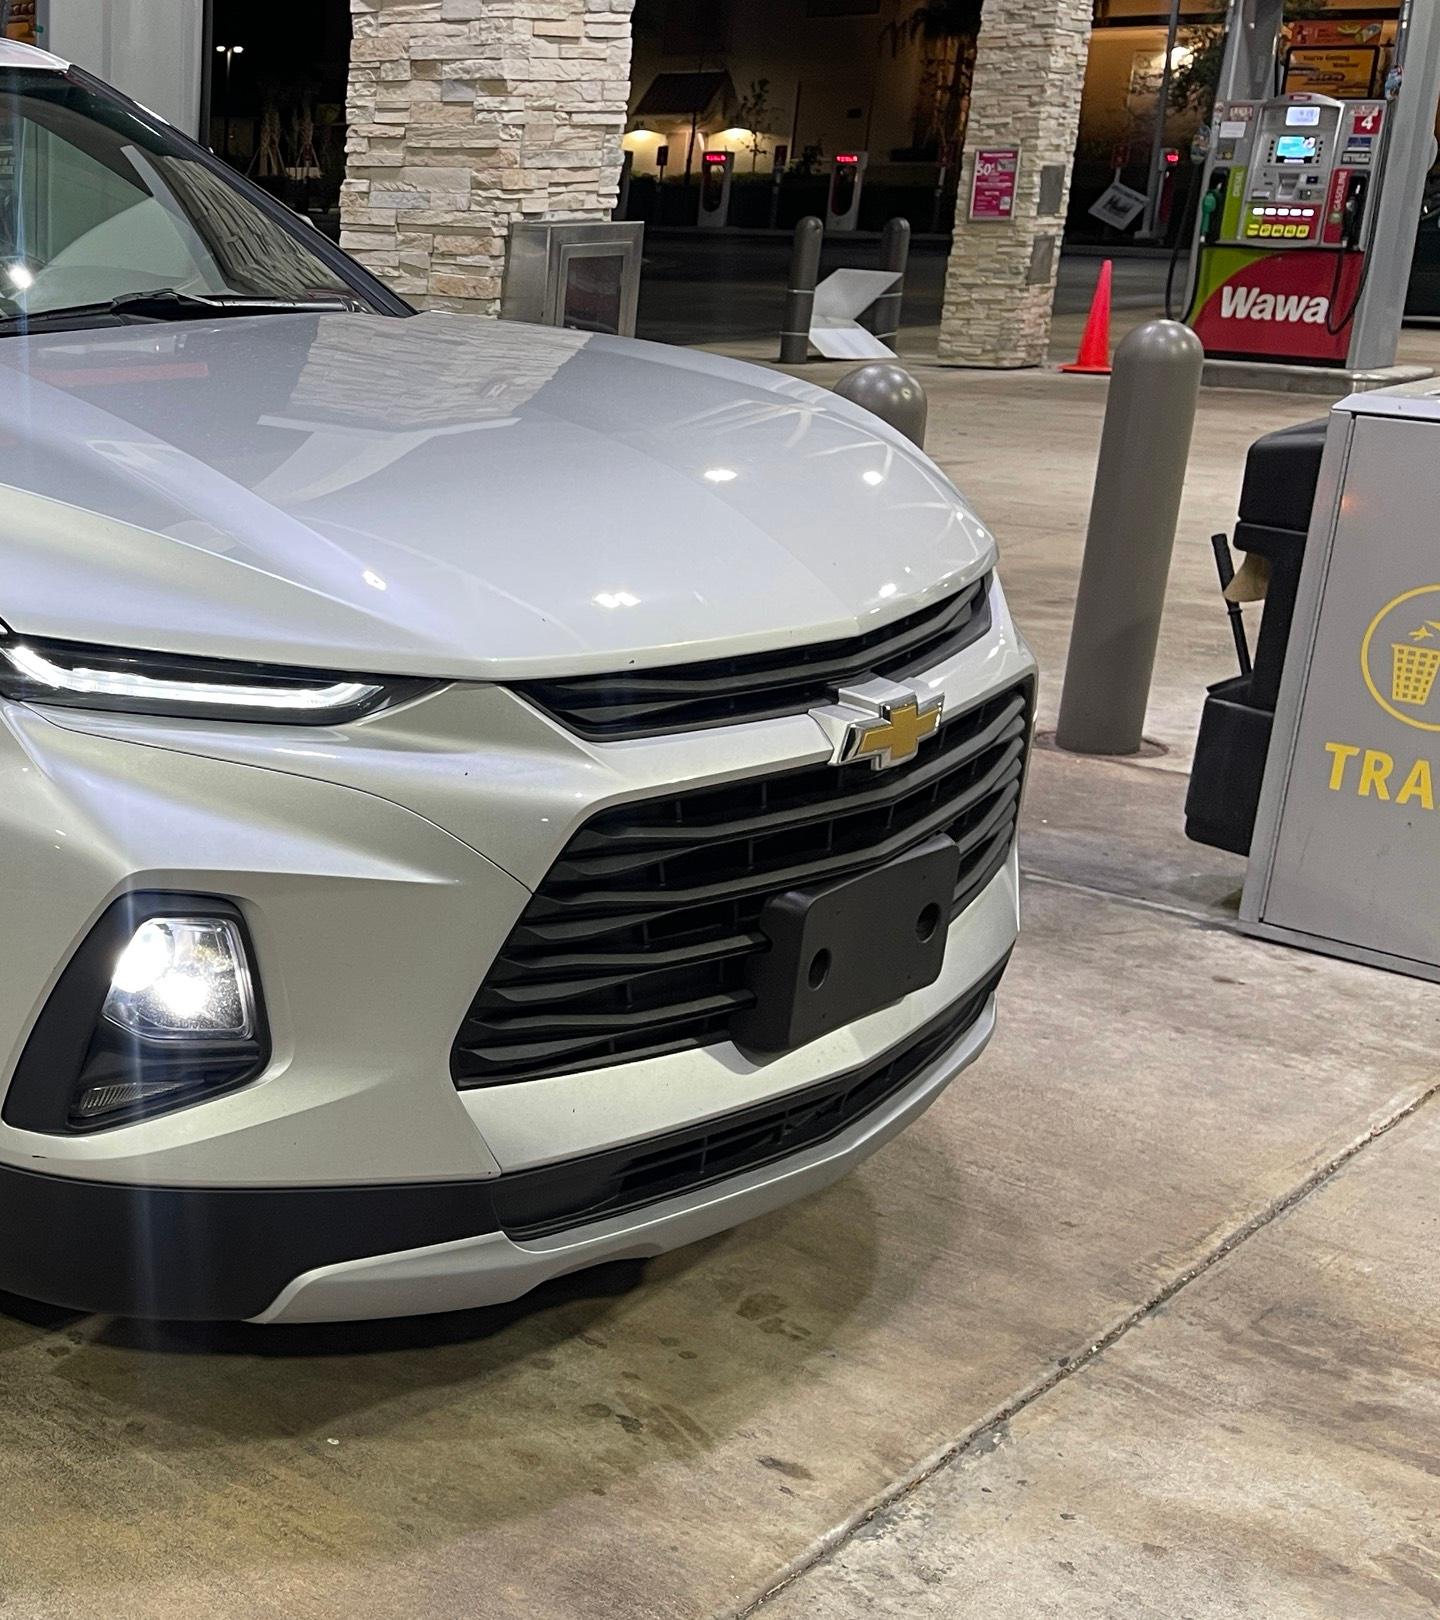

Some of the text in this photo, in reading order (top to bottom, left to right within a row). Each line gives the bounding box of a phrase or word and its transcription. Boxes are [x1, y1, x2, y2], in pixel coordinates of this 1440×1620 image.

[1361, 115, 1373, 130] 4
[1334, 171, 1348, 211] GASOLINE
[1221, 286, 1329, 324] Wawa
[1324, 742, 1440, 810] TRA
